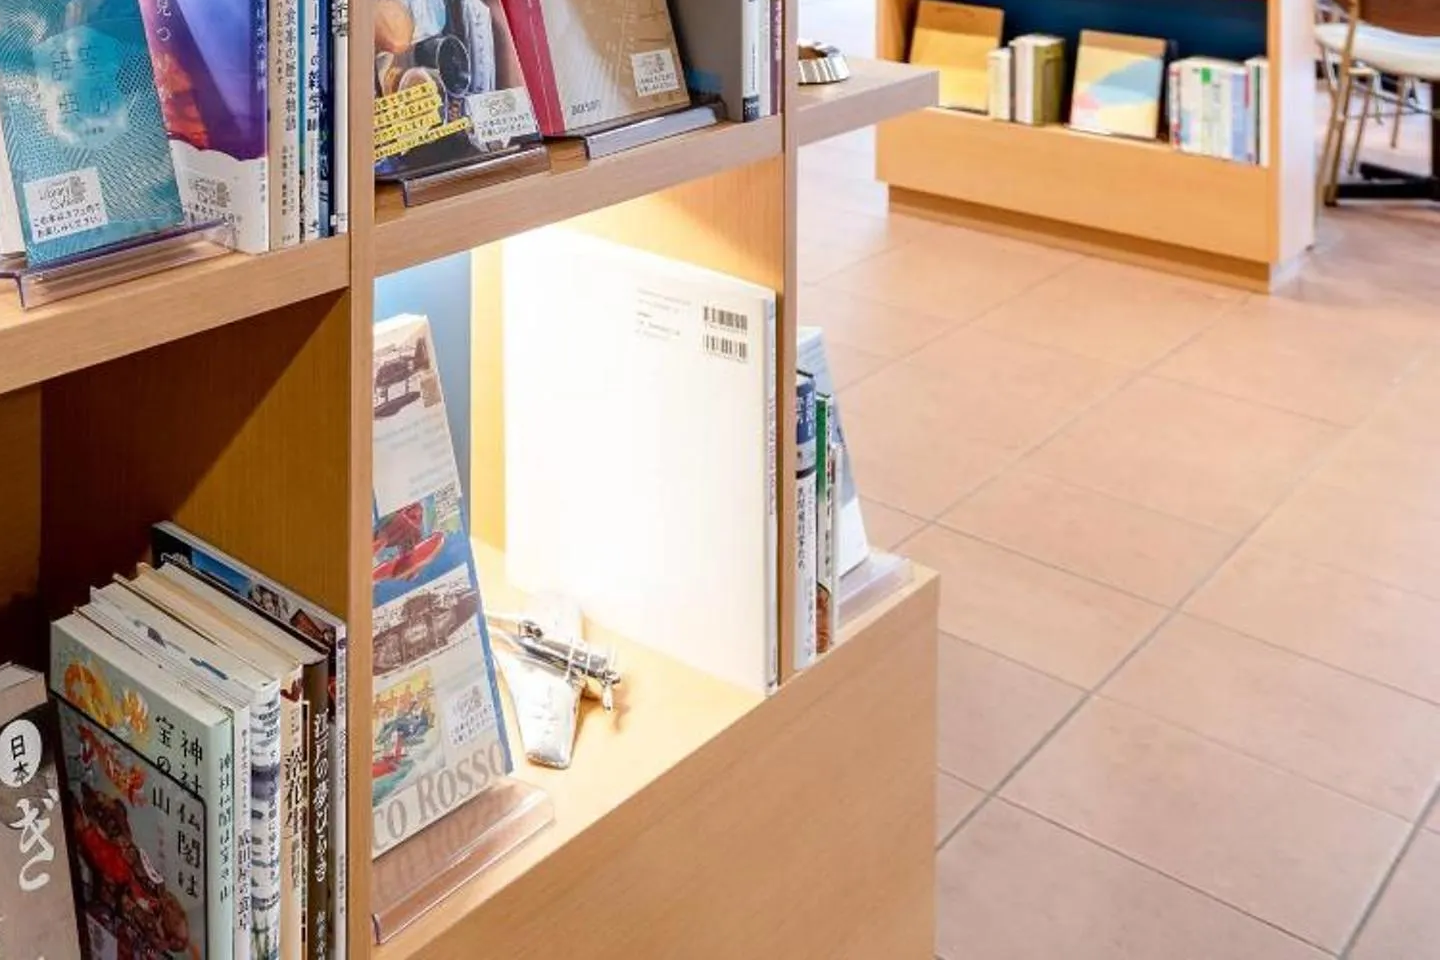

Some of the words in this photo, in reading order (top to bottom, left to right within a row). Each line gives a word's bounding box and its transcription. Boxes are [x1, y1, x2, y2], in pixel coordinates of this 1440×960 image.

[10, 734, 30, 783] 日本
[152, 715, 174, 817] 宝の山
[415, 741, 505, 824] ROSSO
[176, 730, 203, 899] 神社仏閣は
